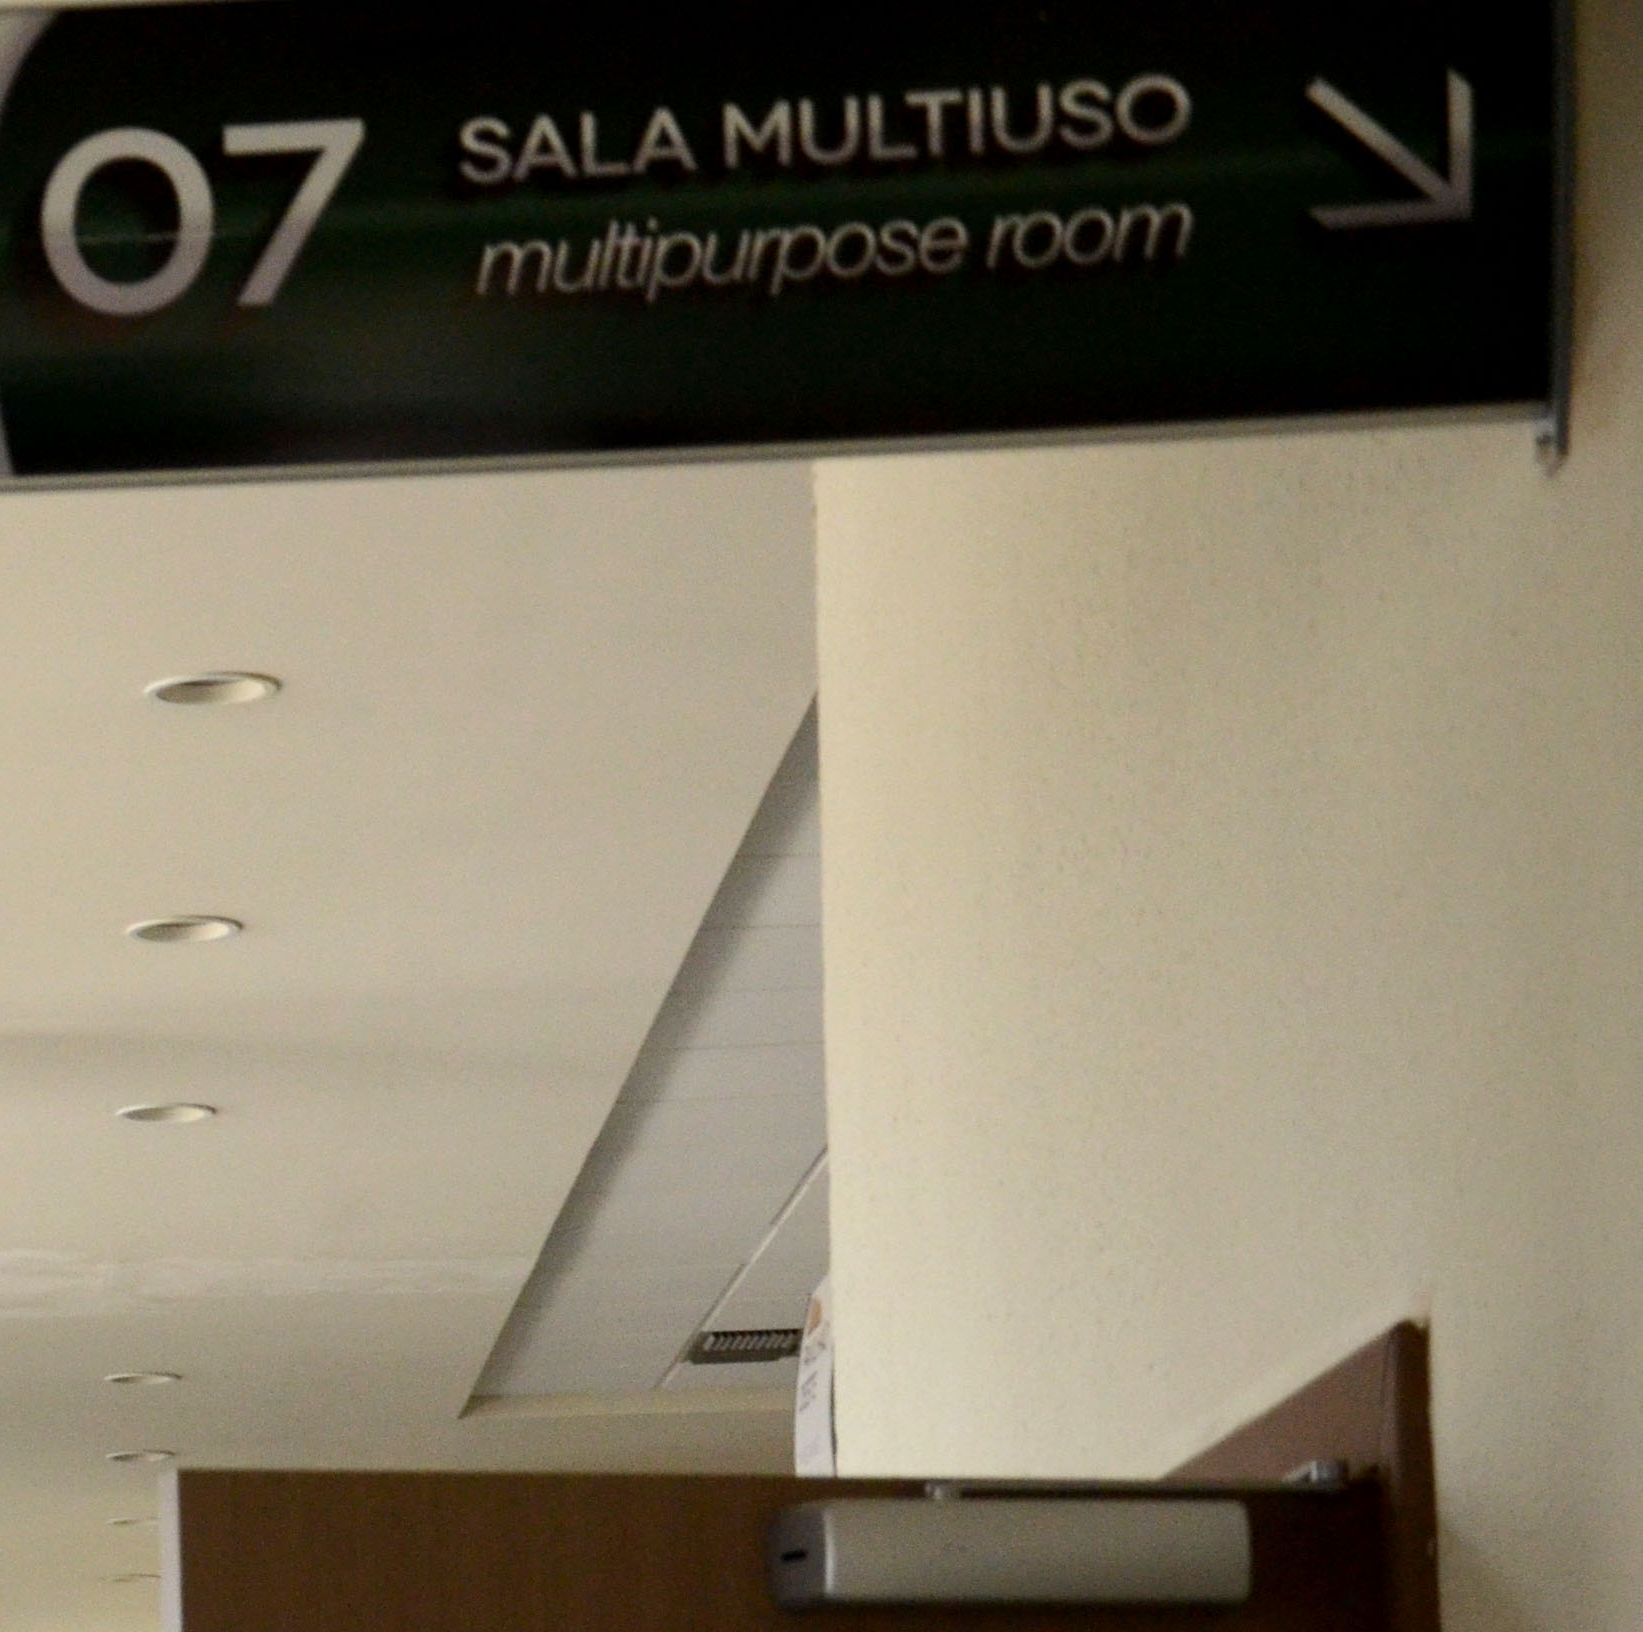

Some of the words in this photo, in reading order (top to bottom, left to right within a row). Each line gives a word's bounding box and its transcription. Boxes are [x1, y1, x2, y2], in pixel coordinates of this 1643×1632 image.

[457, 106, 697, 184] SALA
[724, 74, 1192, 168] MULTIUSO
[40, 117, 366, 318] 07
[475, 216, 967, 303] multipurpose
[986, 202, 1193, 270] room
